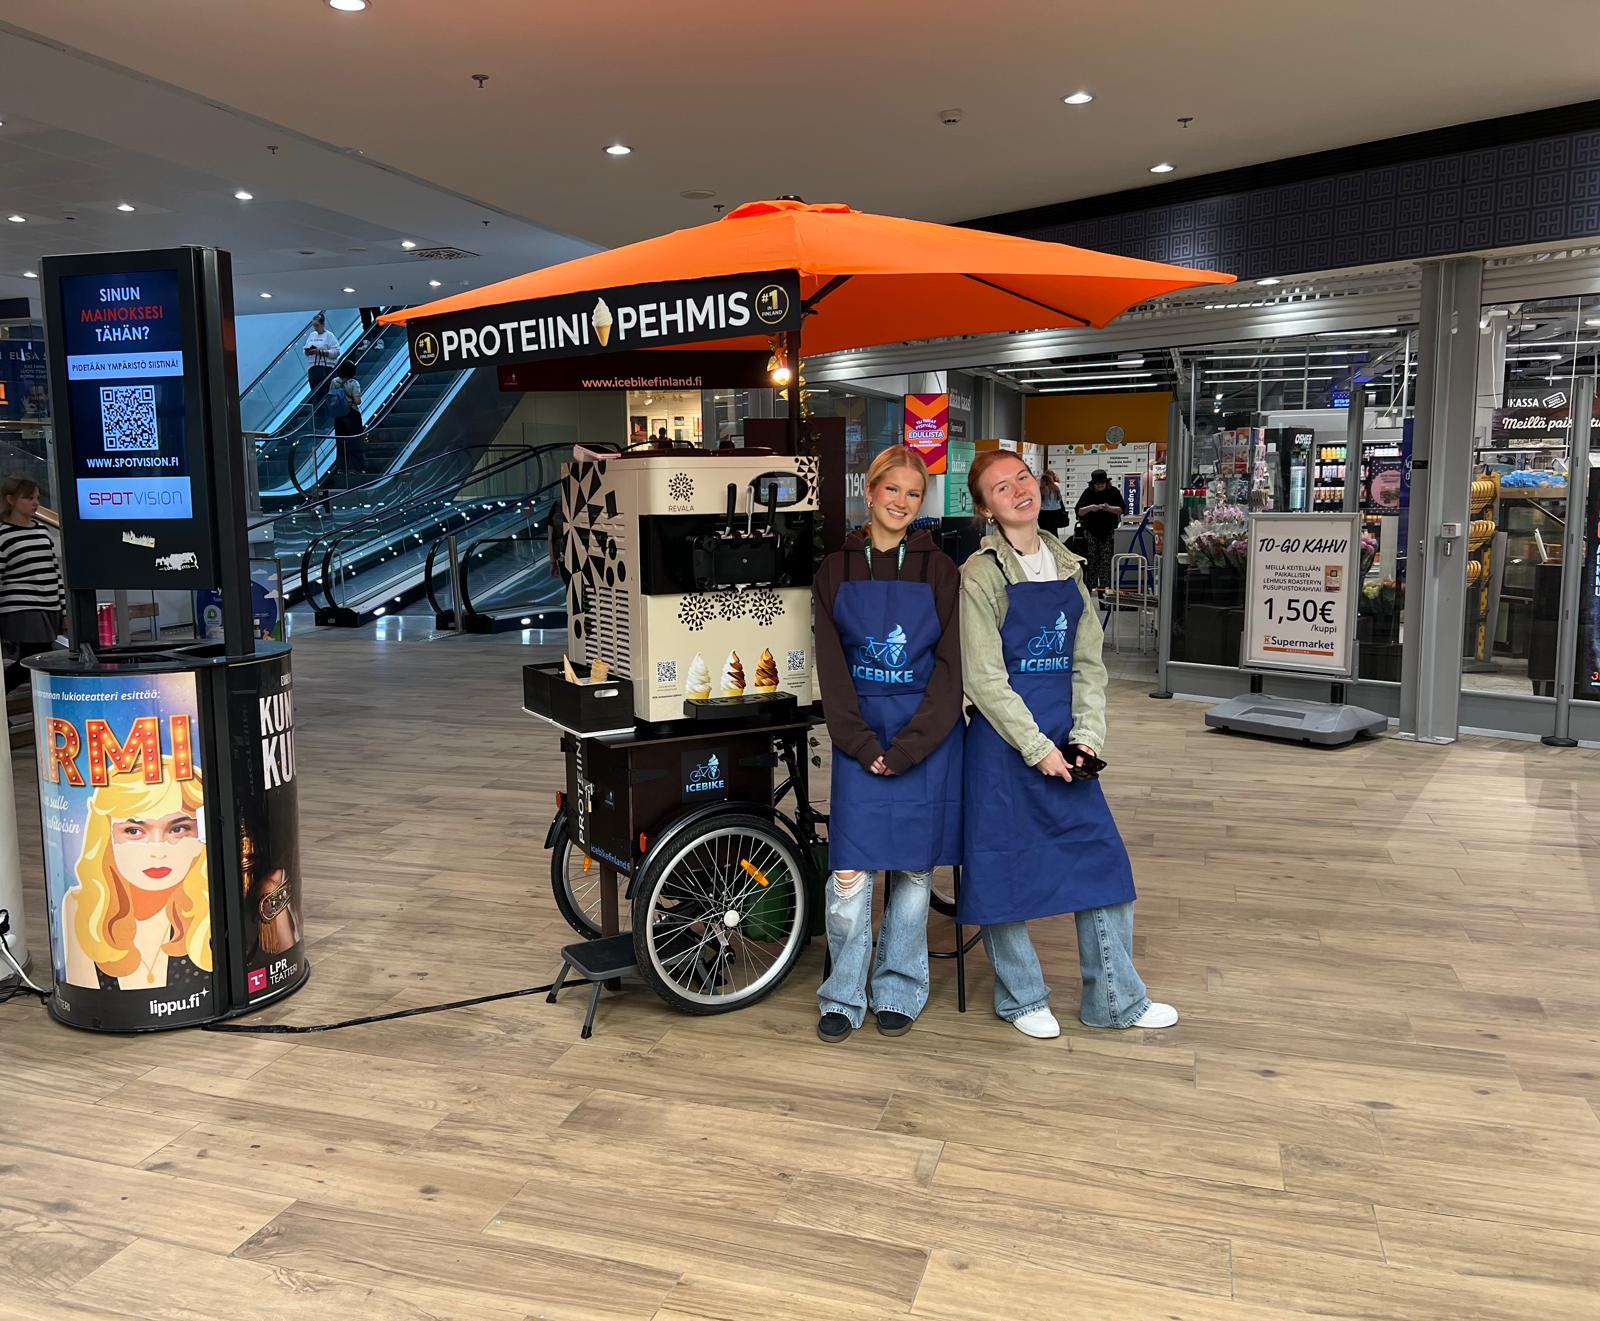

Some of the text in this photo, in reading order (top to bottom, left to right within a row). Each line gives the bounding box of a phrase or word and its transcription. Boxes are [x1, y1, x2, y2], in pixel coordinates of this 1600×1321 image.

[100, 287, 140, 302] SINUN
[761, 289, 778, 310] #1
[81, 305, 164, 322] MAINOKSESI
[96, 324, 150, 342] TÄHÄN?
[442, 291, 750, 361] PROTEIINI PEHMIS
[419, 336, 432, 353] #1
[72, 359, 179, 372] PIDETÄÄN YMPÄRISTÖ SIISTINÄ!
[582, 376, 703, 388] www.icebikefinland.fi
[1502, 416, 1547, 430] Meillä
[908, 430, 944, 439] EDULLISTA
[86, 457, 179, 468] WWW.SPOTVISION.FI
[668, 504, 695, 513] REVALA
[1259, 538, 1347, 553] TO-GO KAHVI
[1286, 564, 1321, 572] KEITELLÄÄN
[1264, 597, 1336, 624] 1,50€
[1310, 624, 1337, 634] /kuppi
[1271, 636, 1335, 650] Supermarket
[1020, 656, 1069, 672] ICEBIKE
[852, 664, 914, 684] ICEBIKE
[62, 691, 118, 701] lukioteatteri
[121, 689, 161, 701] esittää:
[685, 780, 725, 793] ICEBIKE
[270, 958, 288, 976] LPR
[150, 993, 200, 1017] lippu.fi
